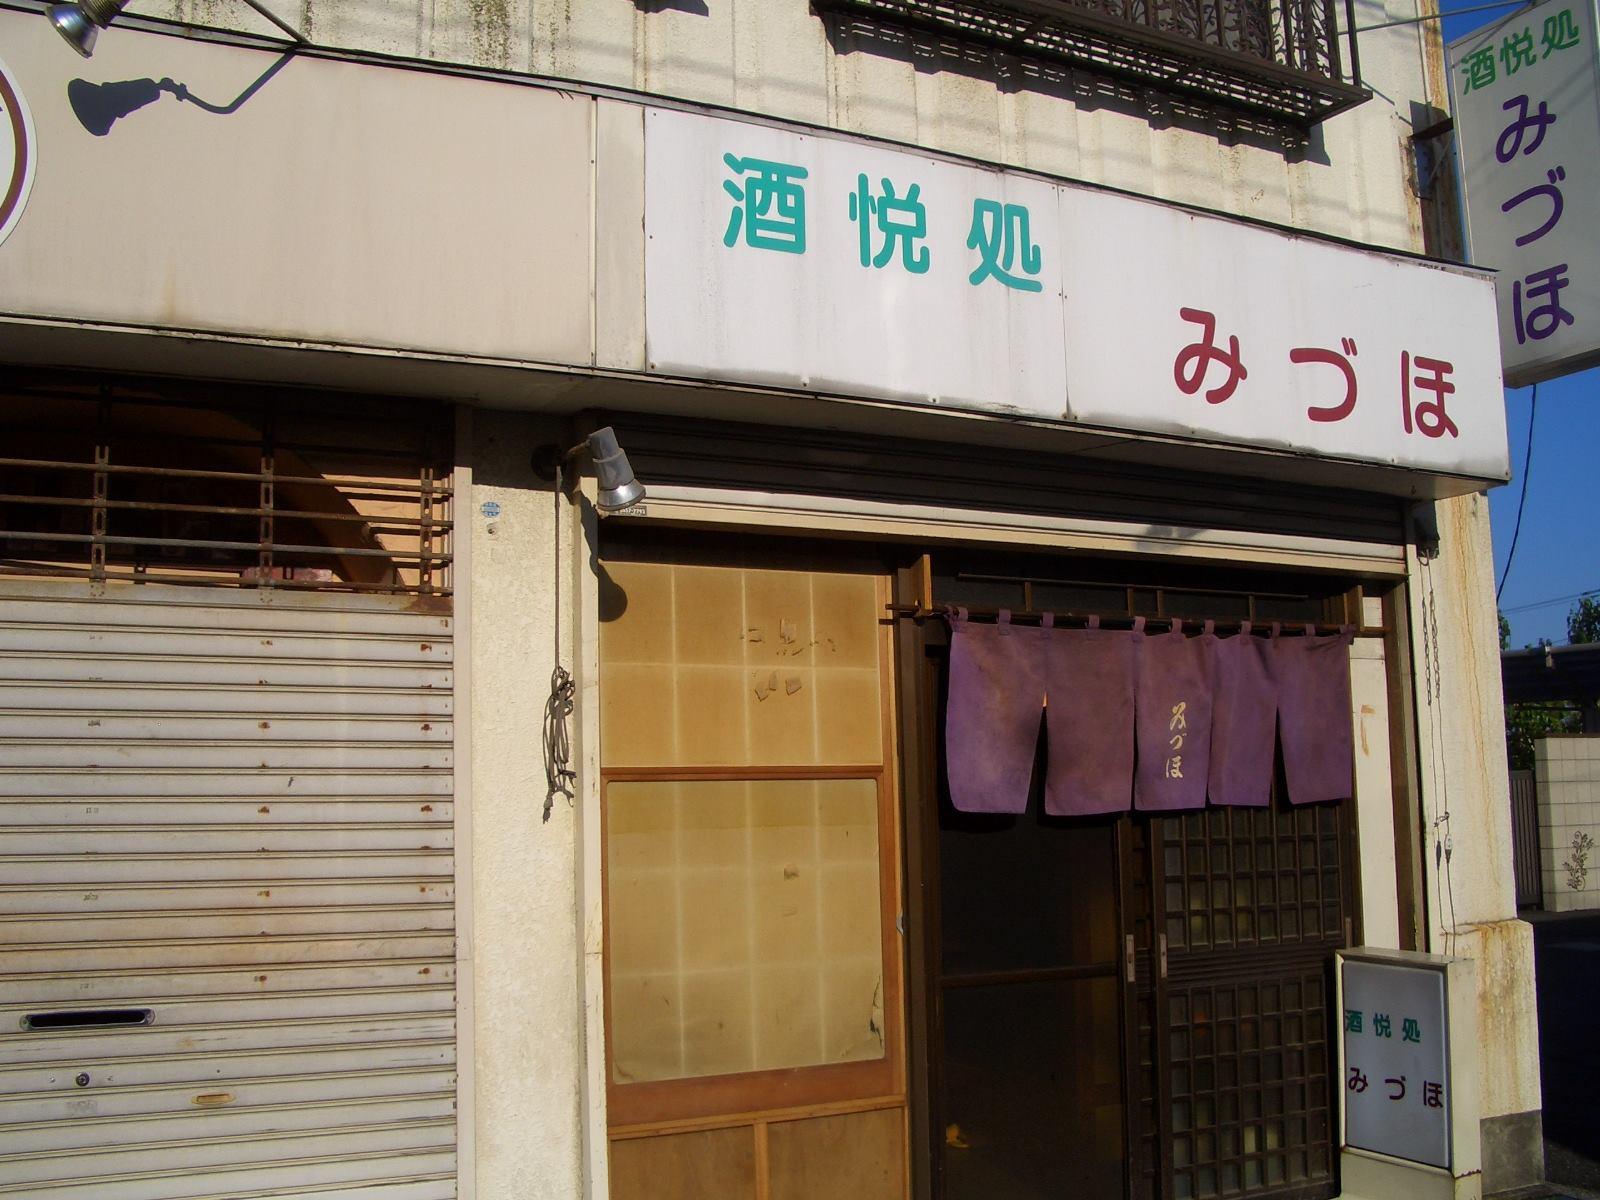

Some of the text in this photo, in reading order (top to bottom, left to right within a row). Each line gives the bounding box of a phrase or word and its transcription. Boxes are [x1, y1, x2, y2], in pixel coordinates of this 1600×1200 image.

[1462, 8, 1580, 95] 酒悦処
[723, 152, 1043, 293] 酒悦処
[1495, 94, 1575, 345] みづほ
[1174, 307, 1459, 438] みづほ
[1166, 702, 1188, 778] みづほ
[1345, 1009, 1421, 1043] 酒悦処
[1348, 1067, 1443, 1108] みづほ
